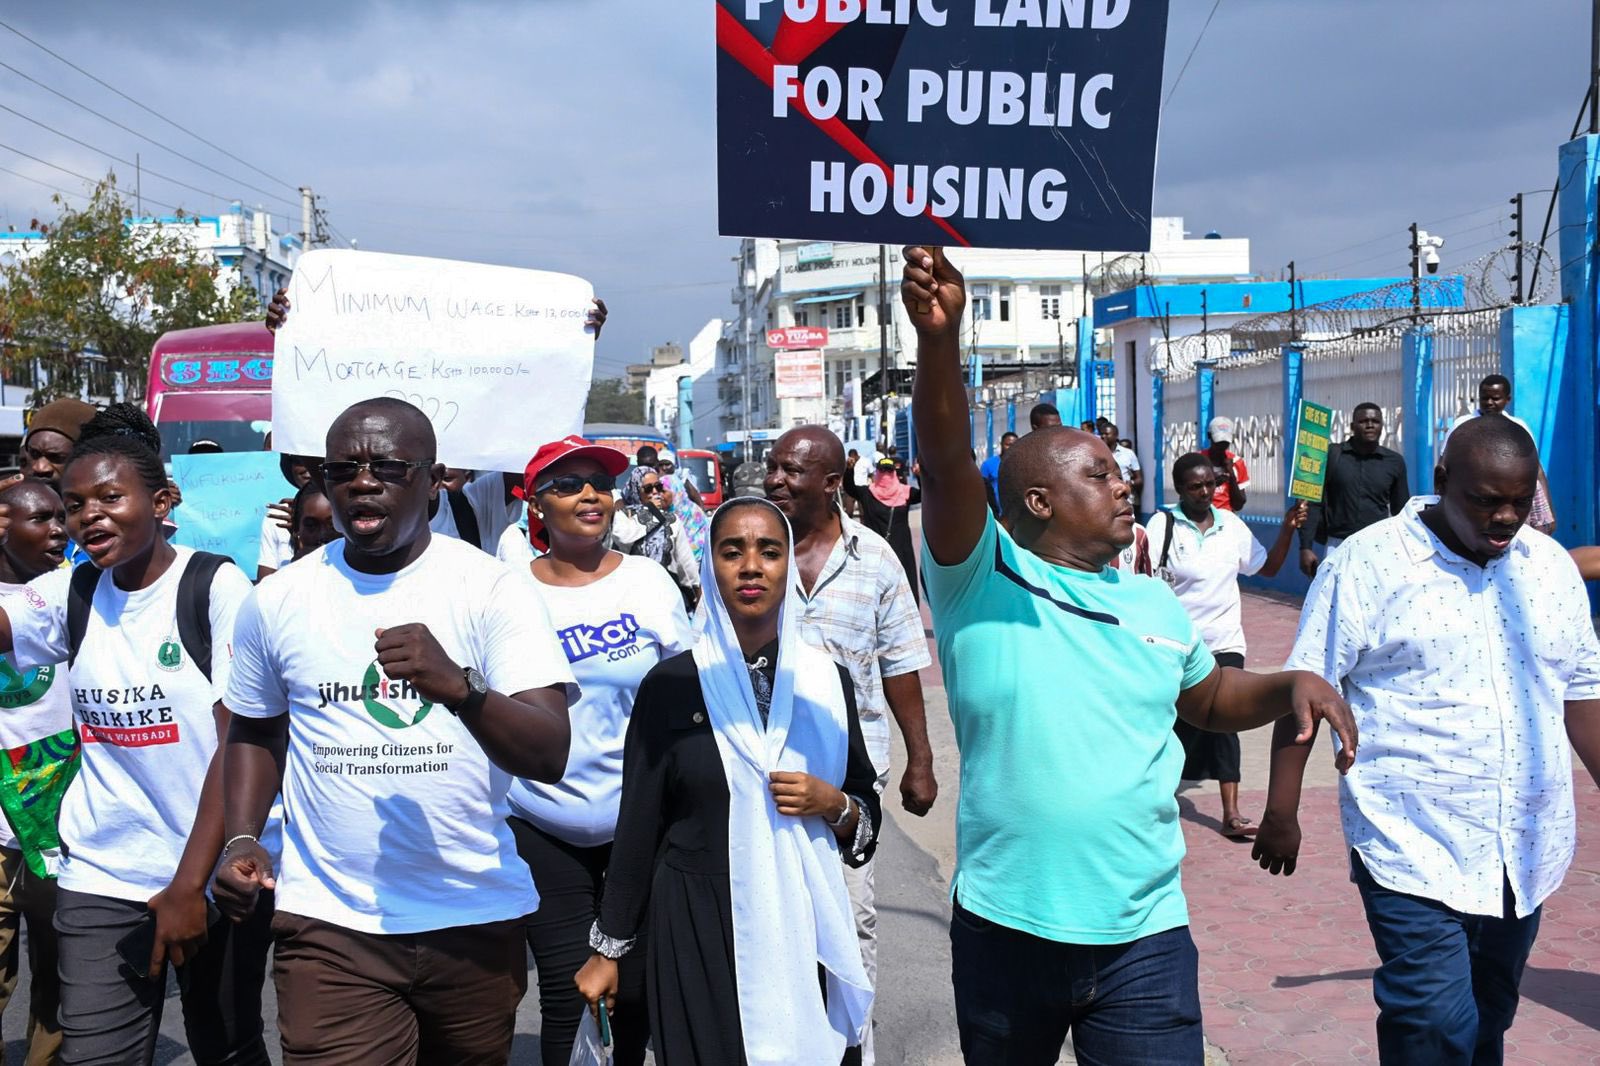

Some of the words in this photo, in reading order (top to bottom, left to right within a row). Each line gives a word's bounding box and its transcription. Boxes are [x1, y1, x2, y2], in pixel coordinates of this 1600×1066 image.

[772, 64, 884, 122] FOR
[907, 69, 1114, 129] PUBLIC
[809, 161, 1069, 222] HOUSING
[295, 265, 431, 321] MINIMUM
[606, 644, 641, 663] .com
[74, 683, 166, 705] HUSIKA
[317, 678, 419, 709] jihusish
[79, 706, 174, 727] USIKIKE
[312, 742, 378, 759] Empowering
[381, 743, 433, 757] Citizens
[436, 742, 454, 755] for
[314, 761, 343, 774] Social
[346, 761, 449, 775] Transformation
